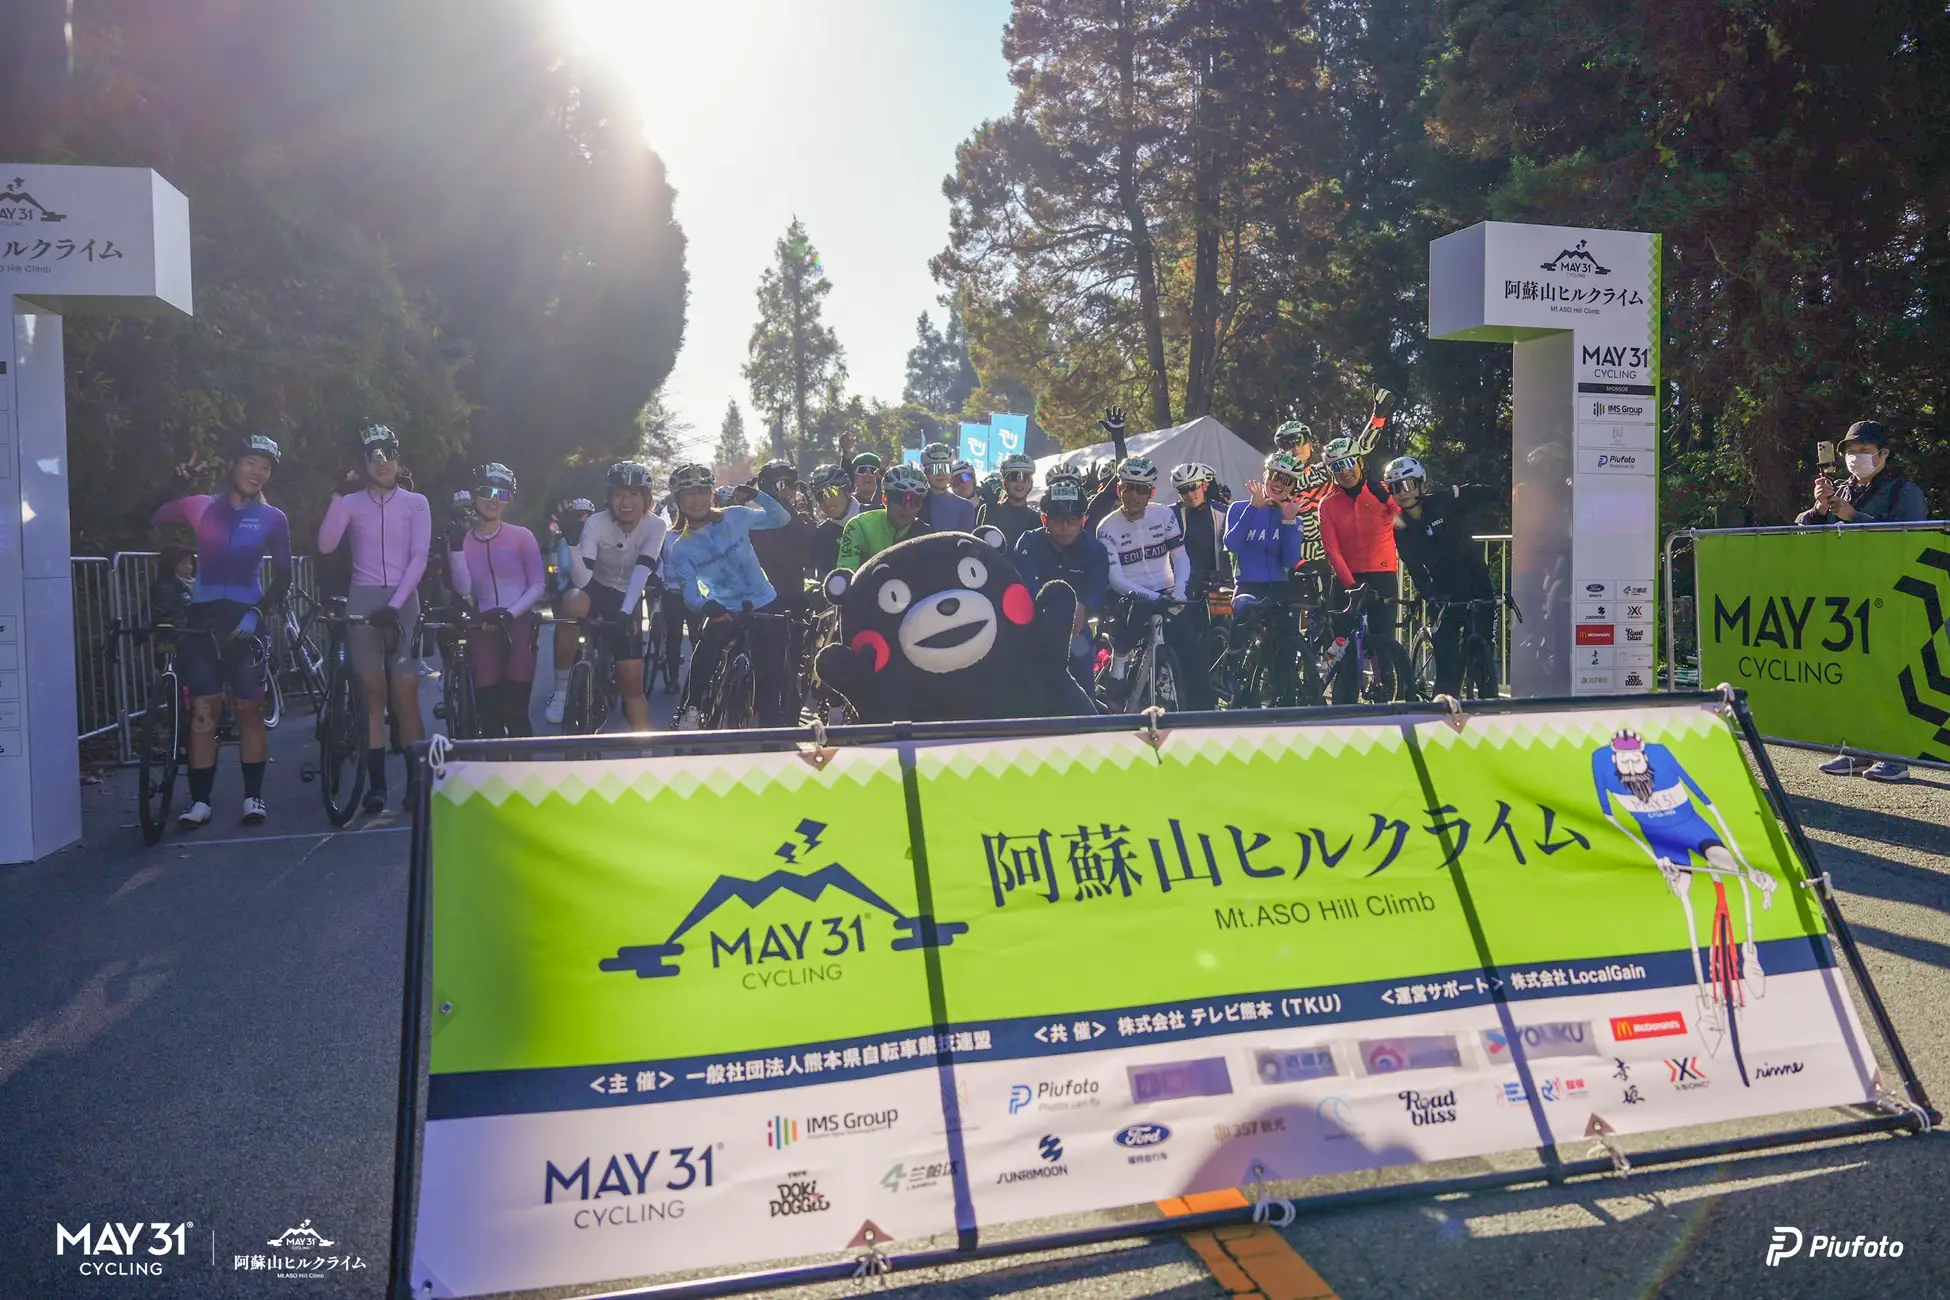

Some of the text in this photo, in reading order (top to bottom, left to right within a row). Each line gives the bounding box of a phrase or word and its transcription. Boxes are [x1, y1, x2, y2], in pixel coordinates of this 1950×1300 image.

[2, 239, 123, 262] ルクライム
[1561, 262, 1581, 273] MAY
[1505, 280, 1643, 307] 阿蘇山ヒルクライム
[1583, 345, 1627, 366] MAY
[1594, 369, 1637, 379] CYCLING
[1608, 405, 1621, 413] IMS
[1622, 405, 1643, 416] Group
[1715, 593, 1817, 650] MAY
[1738, 656, 1843, 685] CYCLING
[980, 799, 1592, 908] 阿蘇山ヒルクライム
[1319, 897, 1360, 920] Hill
[1367, 890, 1436, 918] Climb
[710, 921, 812, 968] MAY
[742, 963, 843, 990] CYCLING
[1511, 968, 1569, 992] 株式会社
[1569, 964, 1647, 985] LocalGain
[1118, 1011, 1186, 1036] 株式会社
[1038, 1078, 1100, 1099] Piufoto
[1398, 1089, 1457, 1111] Road
[807, 1114, 839, 1133] IMS
[843, 1108, 898, 1129] Group
[1411, 1108, 1457, 1126] bliss
[1125, 1126, 1162, 1146] Ford
[544, 1149, 660, 1204] MAY
[574, 1200, 686, 1229] CYCLING
